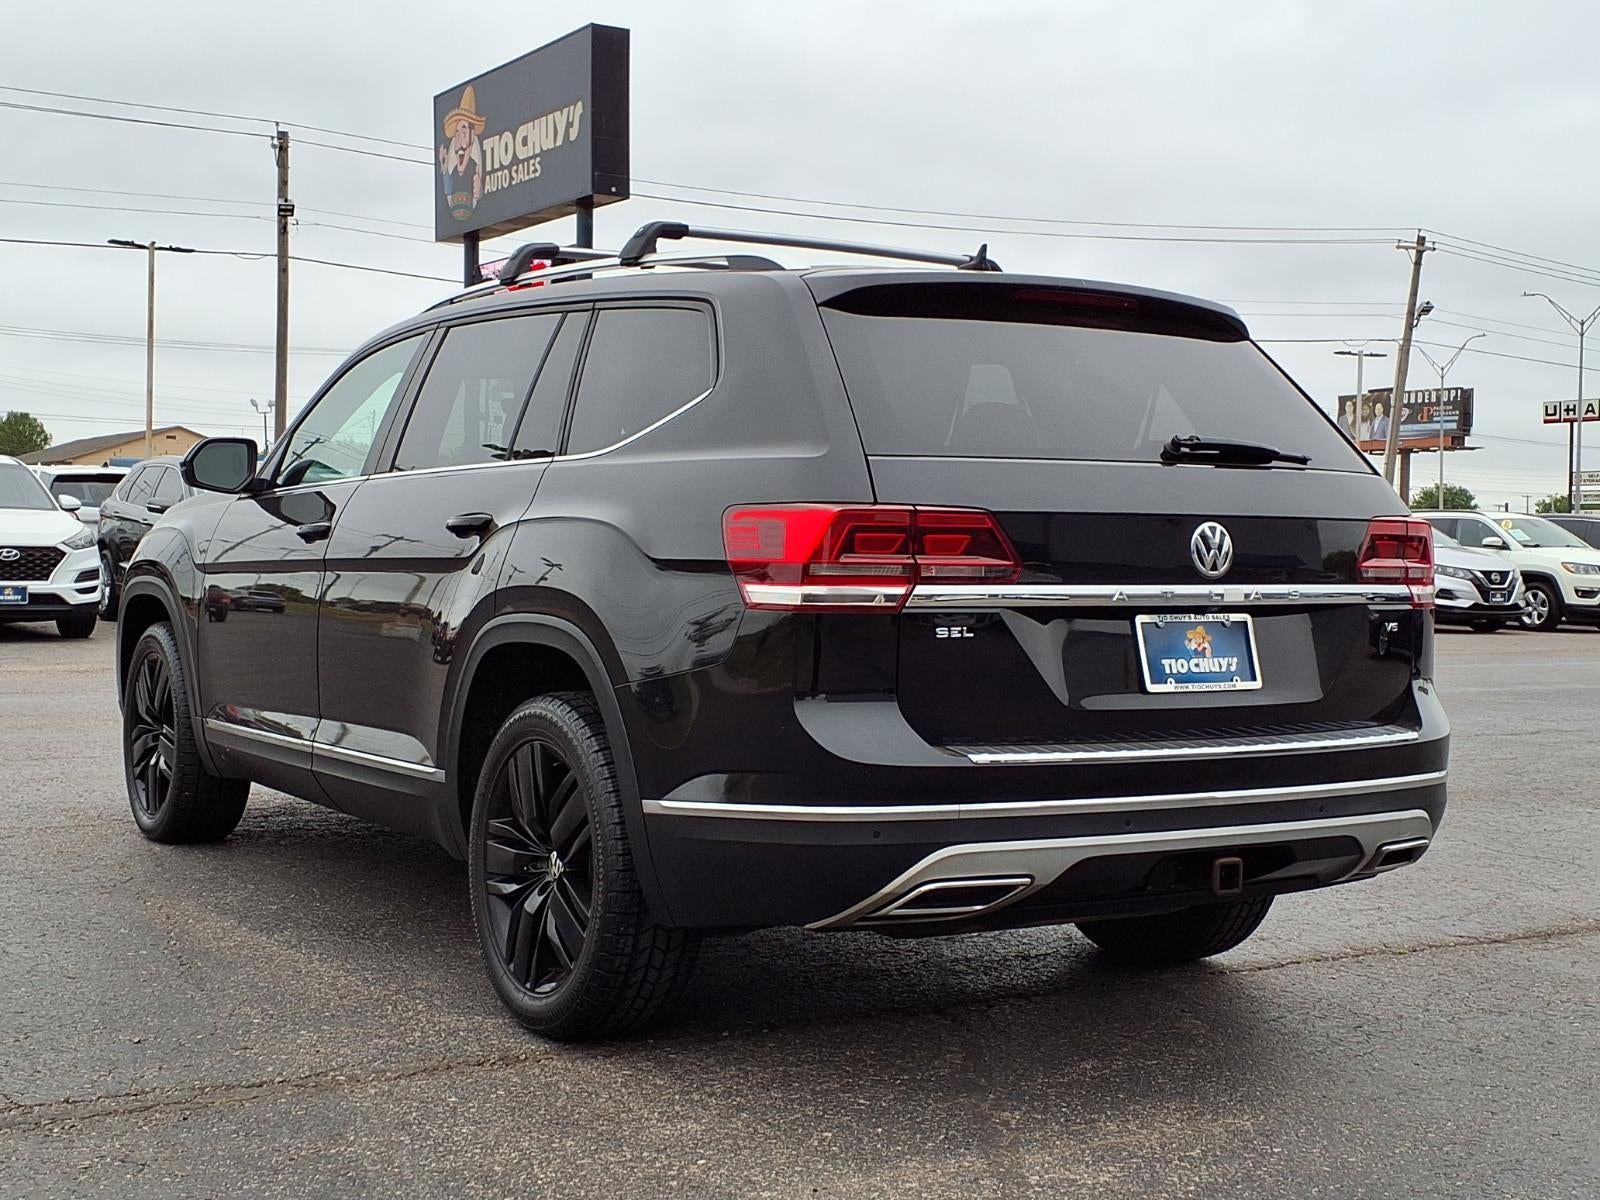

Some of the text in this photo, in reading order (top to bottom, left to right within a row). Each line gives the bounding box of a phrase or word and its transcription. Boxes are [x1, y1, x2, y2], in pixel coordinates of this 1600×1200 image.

[483, 101, 583, 171] TIO CHUY'S
[484, 157, 541, 194] AUTO SALES
[1112, 588, 1300, 601] ATLAS
[935, 626, 975, 638] SEL
[1161, 656, 1238, 674] TIO CHUY'S
